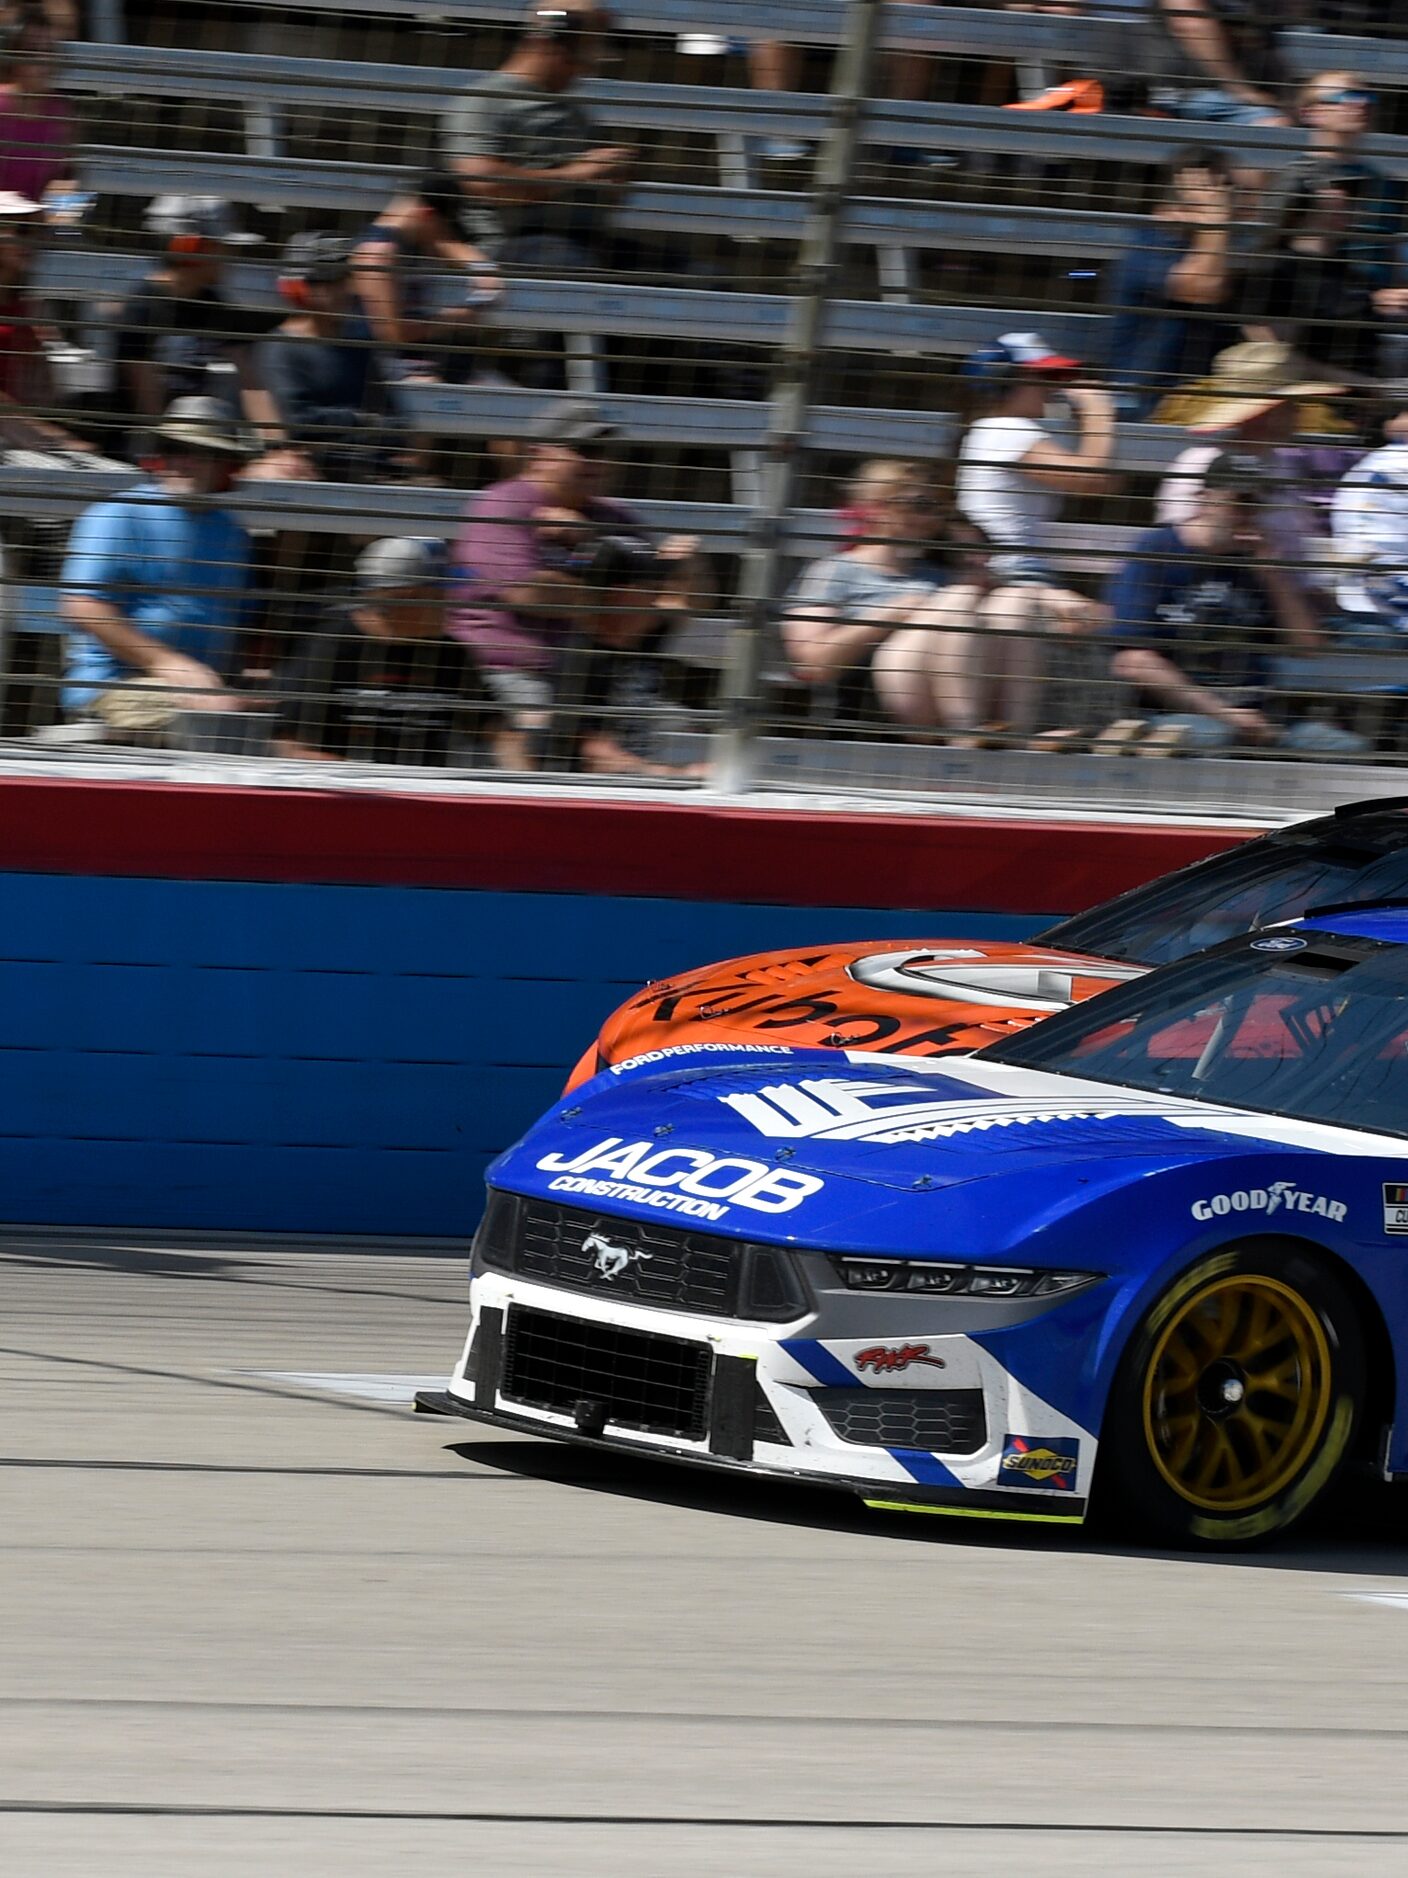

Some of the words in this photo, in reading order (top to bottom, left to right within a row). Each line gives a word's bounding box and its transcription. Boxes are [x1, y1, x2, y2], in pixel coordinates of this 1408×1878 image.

[629, 978, 982, 1058] Kubot
[610, 1049, 666, 1076] FORD
[663, 1042, 794, 1061] PERFORMANCE
[536, 1138, 825, 1214] JACOB
[548, 1175, 731, 1221] CONSTRUCTION
[1191, 1186, 1348, 1222] GOODYEAR
[1005, 1454, 1074, 1473] SUNOCO
